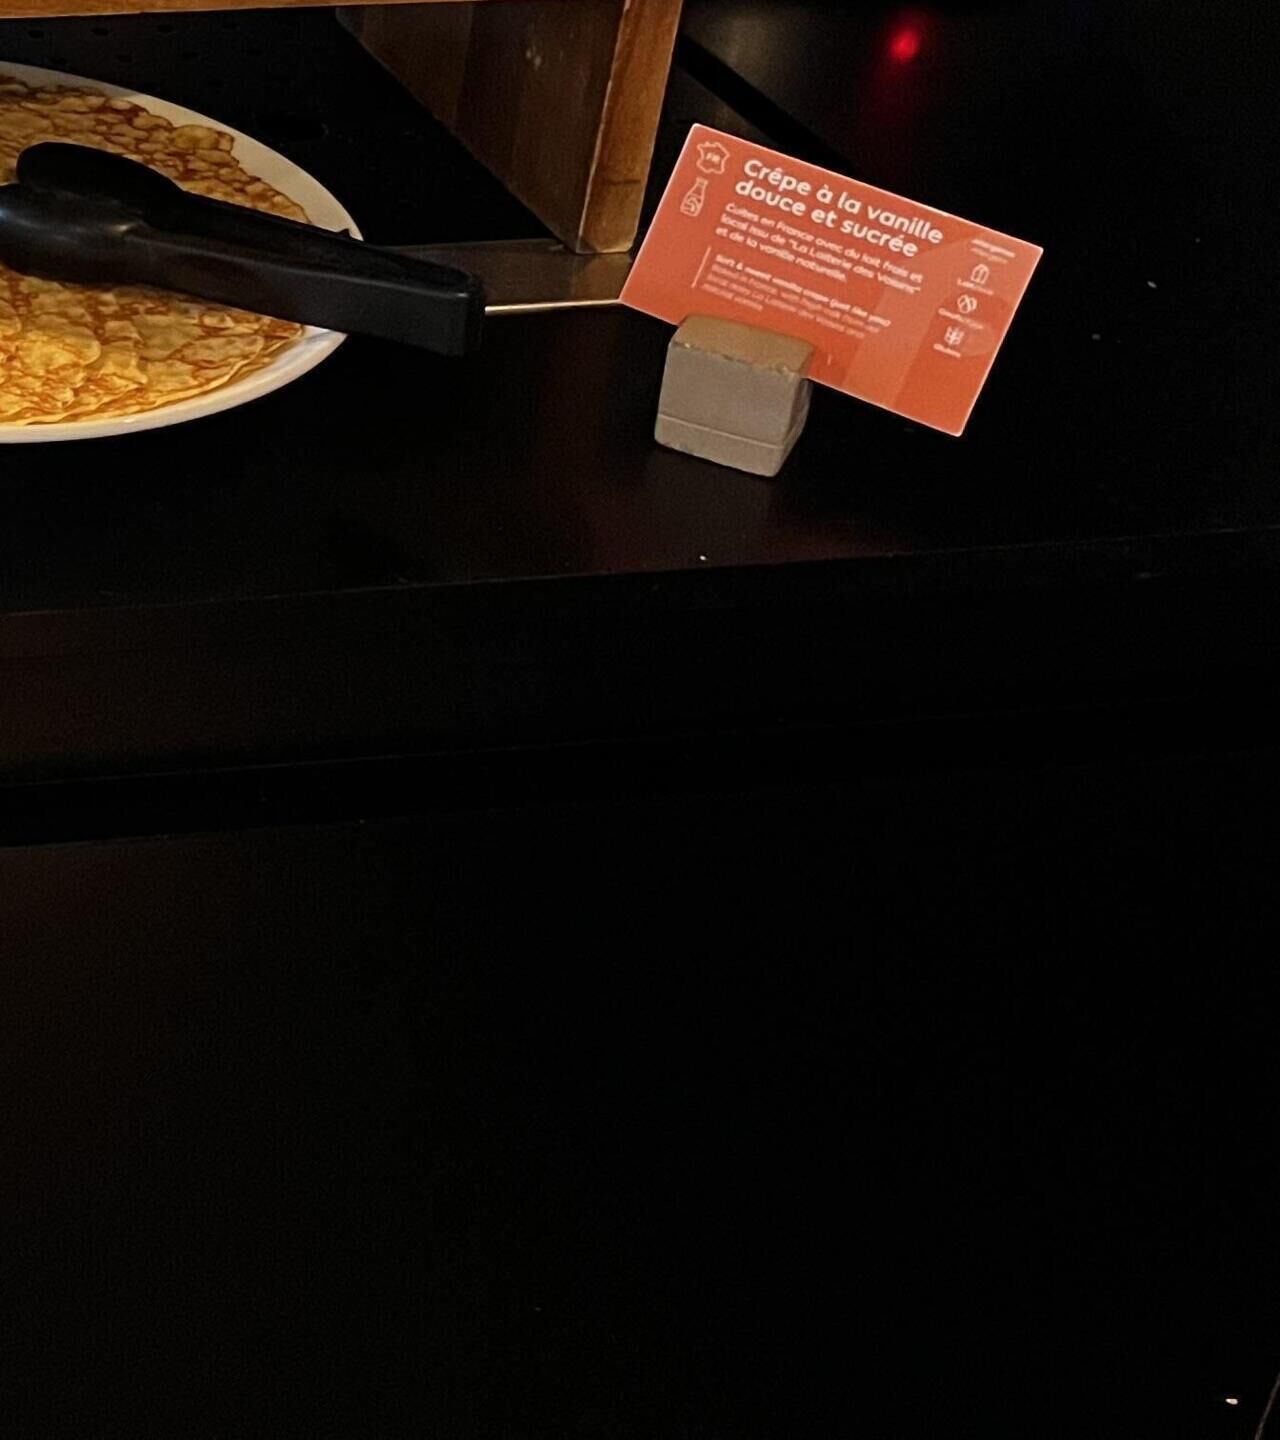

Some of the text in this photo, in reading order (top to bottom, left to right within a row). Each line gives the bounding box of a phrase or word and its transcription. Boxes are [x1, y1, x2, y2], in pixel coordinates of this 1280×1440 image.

[735, 180, 919, 257] douce et sucrée
[743, 159, 944, 244] Crêpe à la vanille
